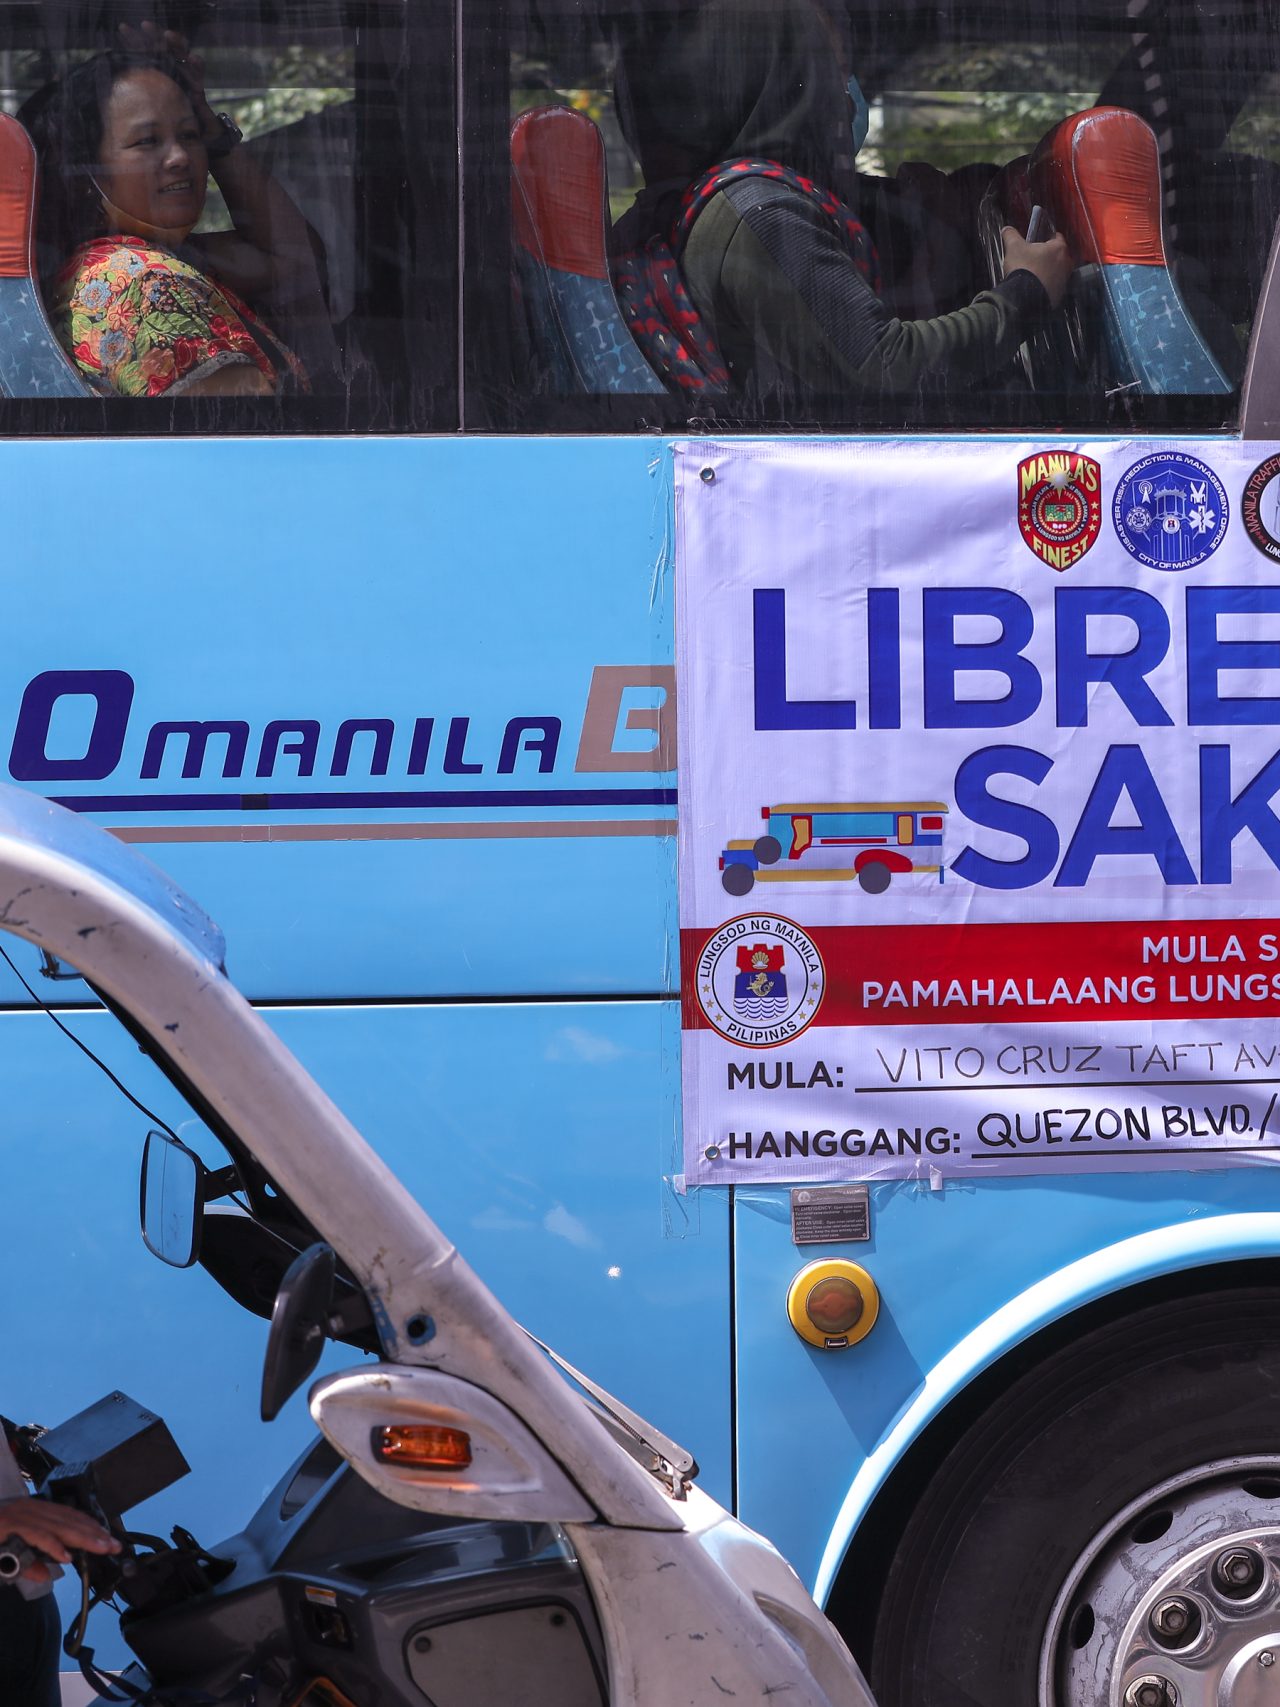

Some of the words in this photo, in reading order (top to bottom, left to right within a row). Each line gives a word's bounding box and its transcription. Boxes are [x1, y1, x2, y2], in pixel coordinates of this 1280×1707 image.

[1125, 454, 1174, 484] REDUCTION
[1184, 456, 1228, 515] MANAGEMENT
[1115, 484, 1127, 506] RISK
[1243, 490, 1260, 533] MANILA
[1114, 507, 1136, 552] DISASTER
[1210, 516, 1229, 550] OFFICE
[1033, 534, 1089, 569] FINEST
[1138, 552, 1159, 566] CITY
[1158, 561, 1173, 570] OF
[1172, 551, 1207, 570] MANILA
[700, 923, 746, 979] LUNGSOD
[751, 920, 771, 931] NG
[774, 922, 819, 973] MAYNILA
[1142, 935, 1246, 965] MULA
[862, 974, 1156, 1009] PAMAHALAANG
[726, 1020, 797, 1042] PILIPINAS
[727, 1060, 844, 1090] MULA:
[876, 1047, 984, 1084] VITO
[996, 1042, 1102, 1076] CRUZ
[1113, 1041, 1222, 1074] TAFT
[729, 1126, 961, 1160] HANGGANG:
[976, 1108, 1151, 1147] QUEZON
